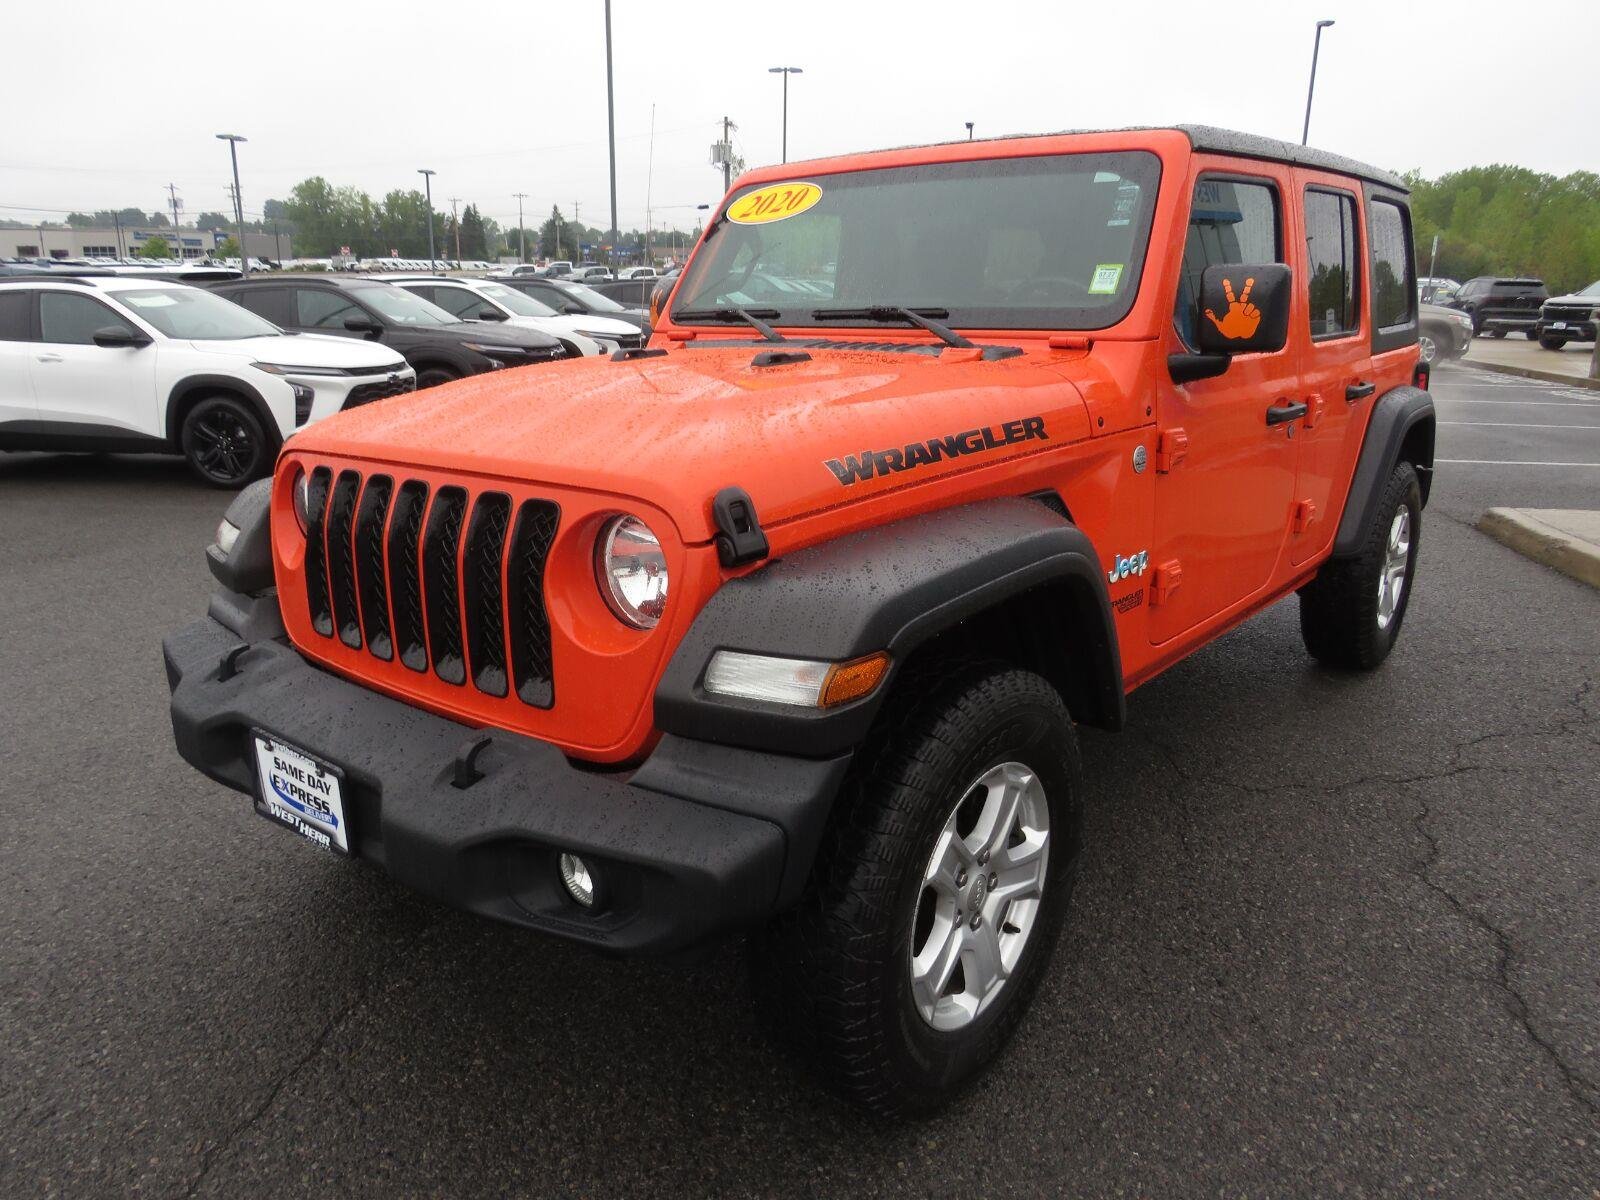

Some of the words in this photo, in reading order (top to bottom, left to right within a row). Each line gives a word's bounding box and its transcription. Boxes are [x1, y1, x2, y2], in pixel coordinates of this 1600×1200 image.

[739, 186, 810, 219] 2020
[823, 416, 1049, 486] WRANGLER
[1108, 550, 1149, 583] Jeep
[273, 756, 305, 783] SAME
[307, 773, 332, 796] DAY
[273, 774, 331, 815] EXPRESS
[270, 802, 302, 827] WEST
[300, 822, 331, 848] HERR
[304, 807, 334, 824] DELIVERY
